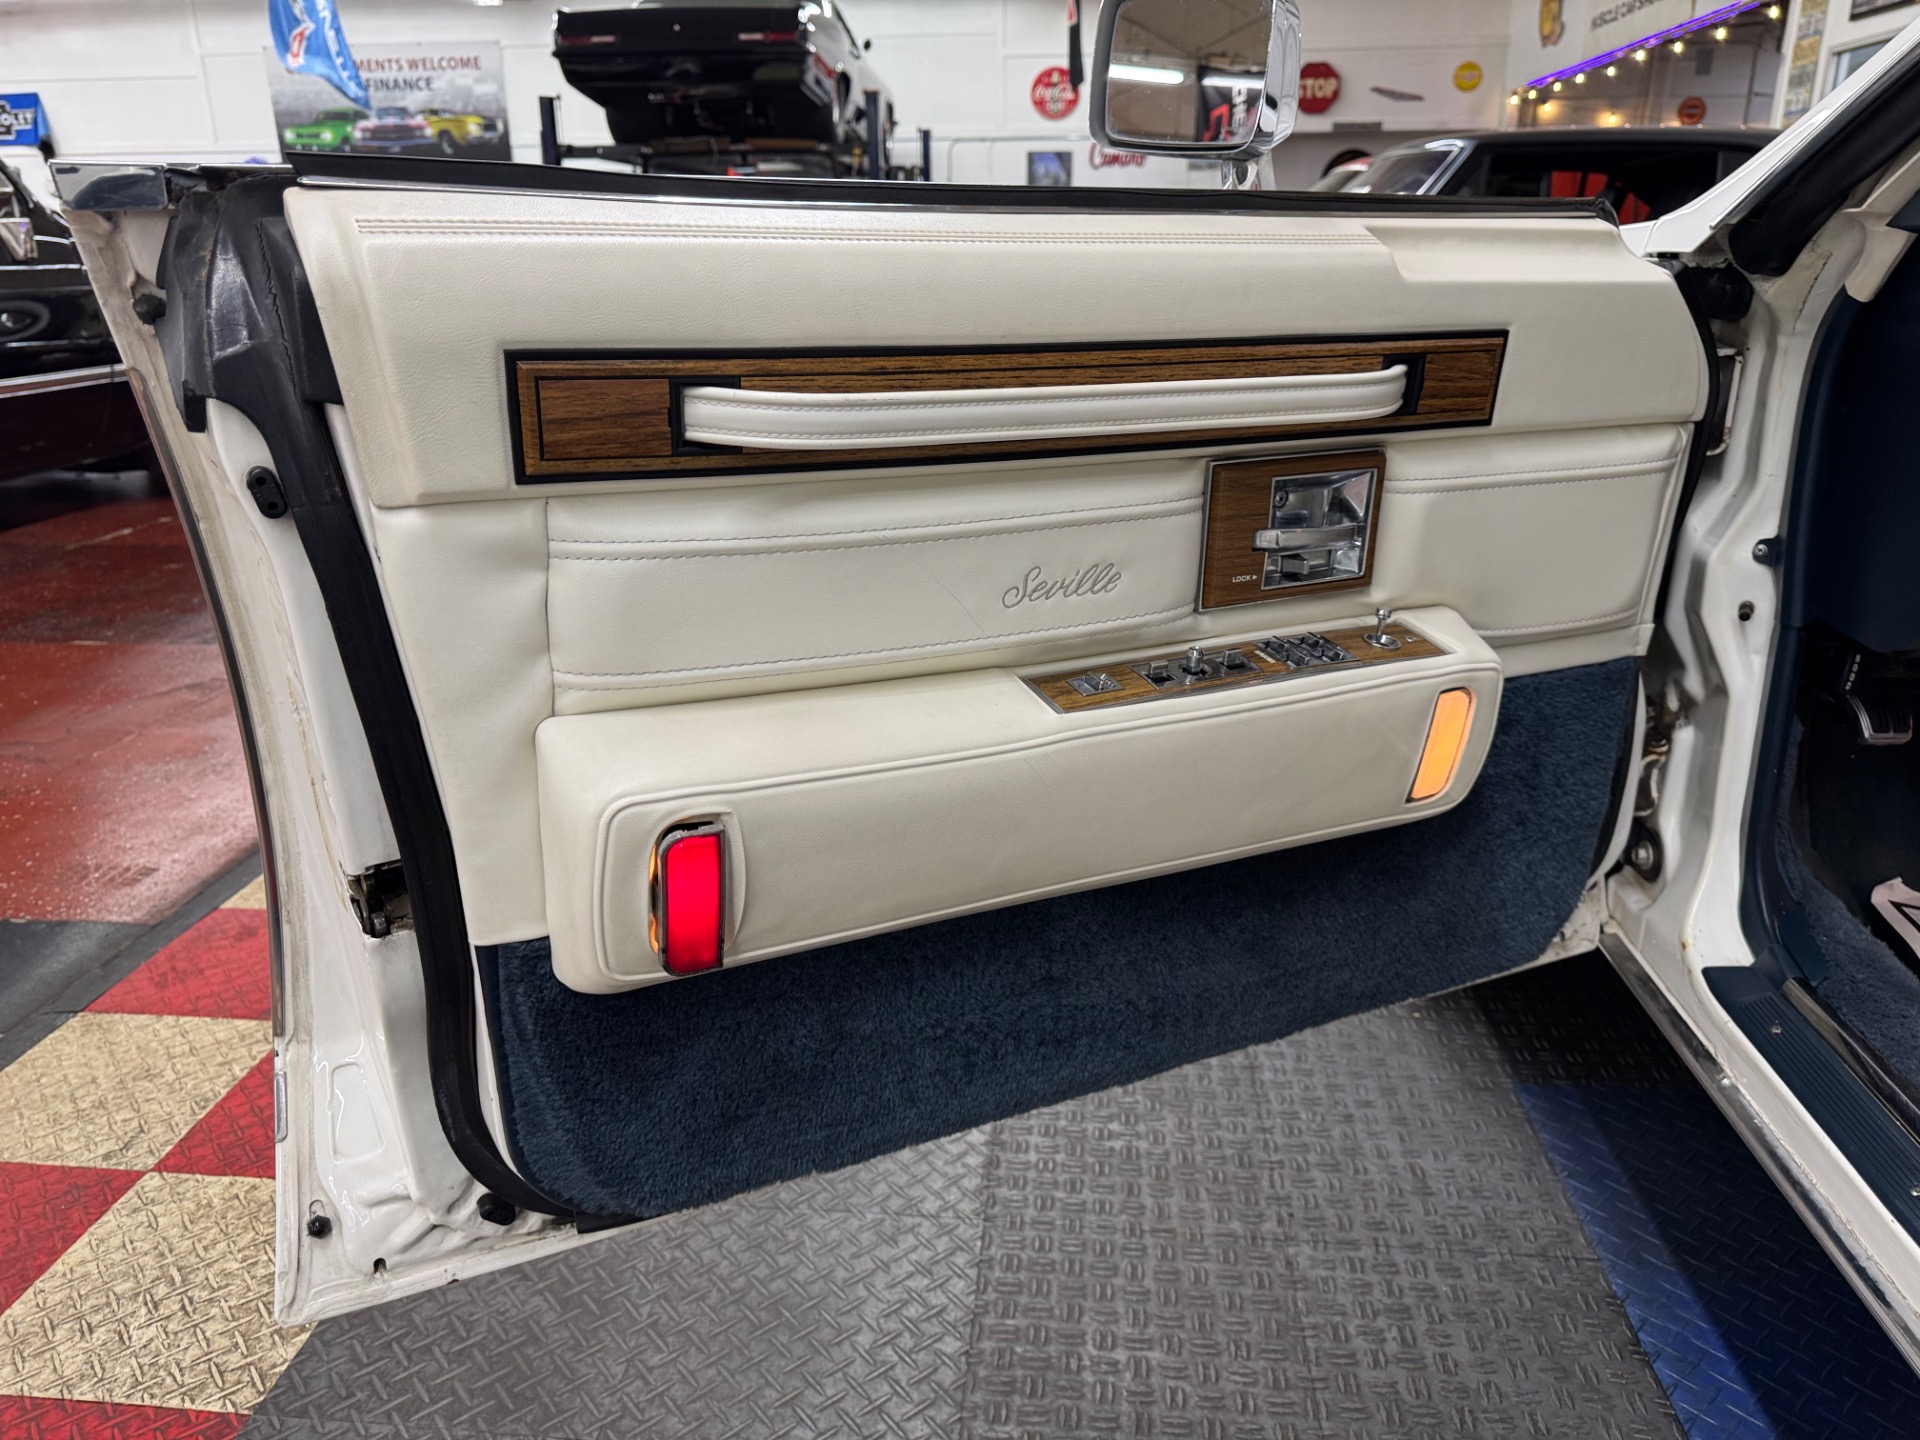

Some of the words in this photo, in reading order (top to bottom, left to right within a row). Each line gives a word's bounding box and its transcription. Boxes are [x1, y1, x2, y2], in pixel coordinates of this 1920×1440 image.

[405, 54, 482, 71] WELCOME
[365, 75, 434, 92] FINANCE
[1001, 562, 1122, 609] Seville
[1232, 574, 1252, 583] LOCK
